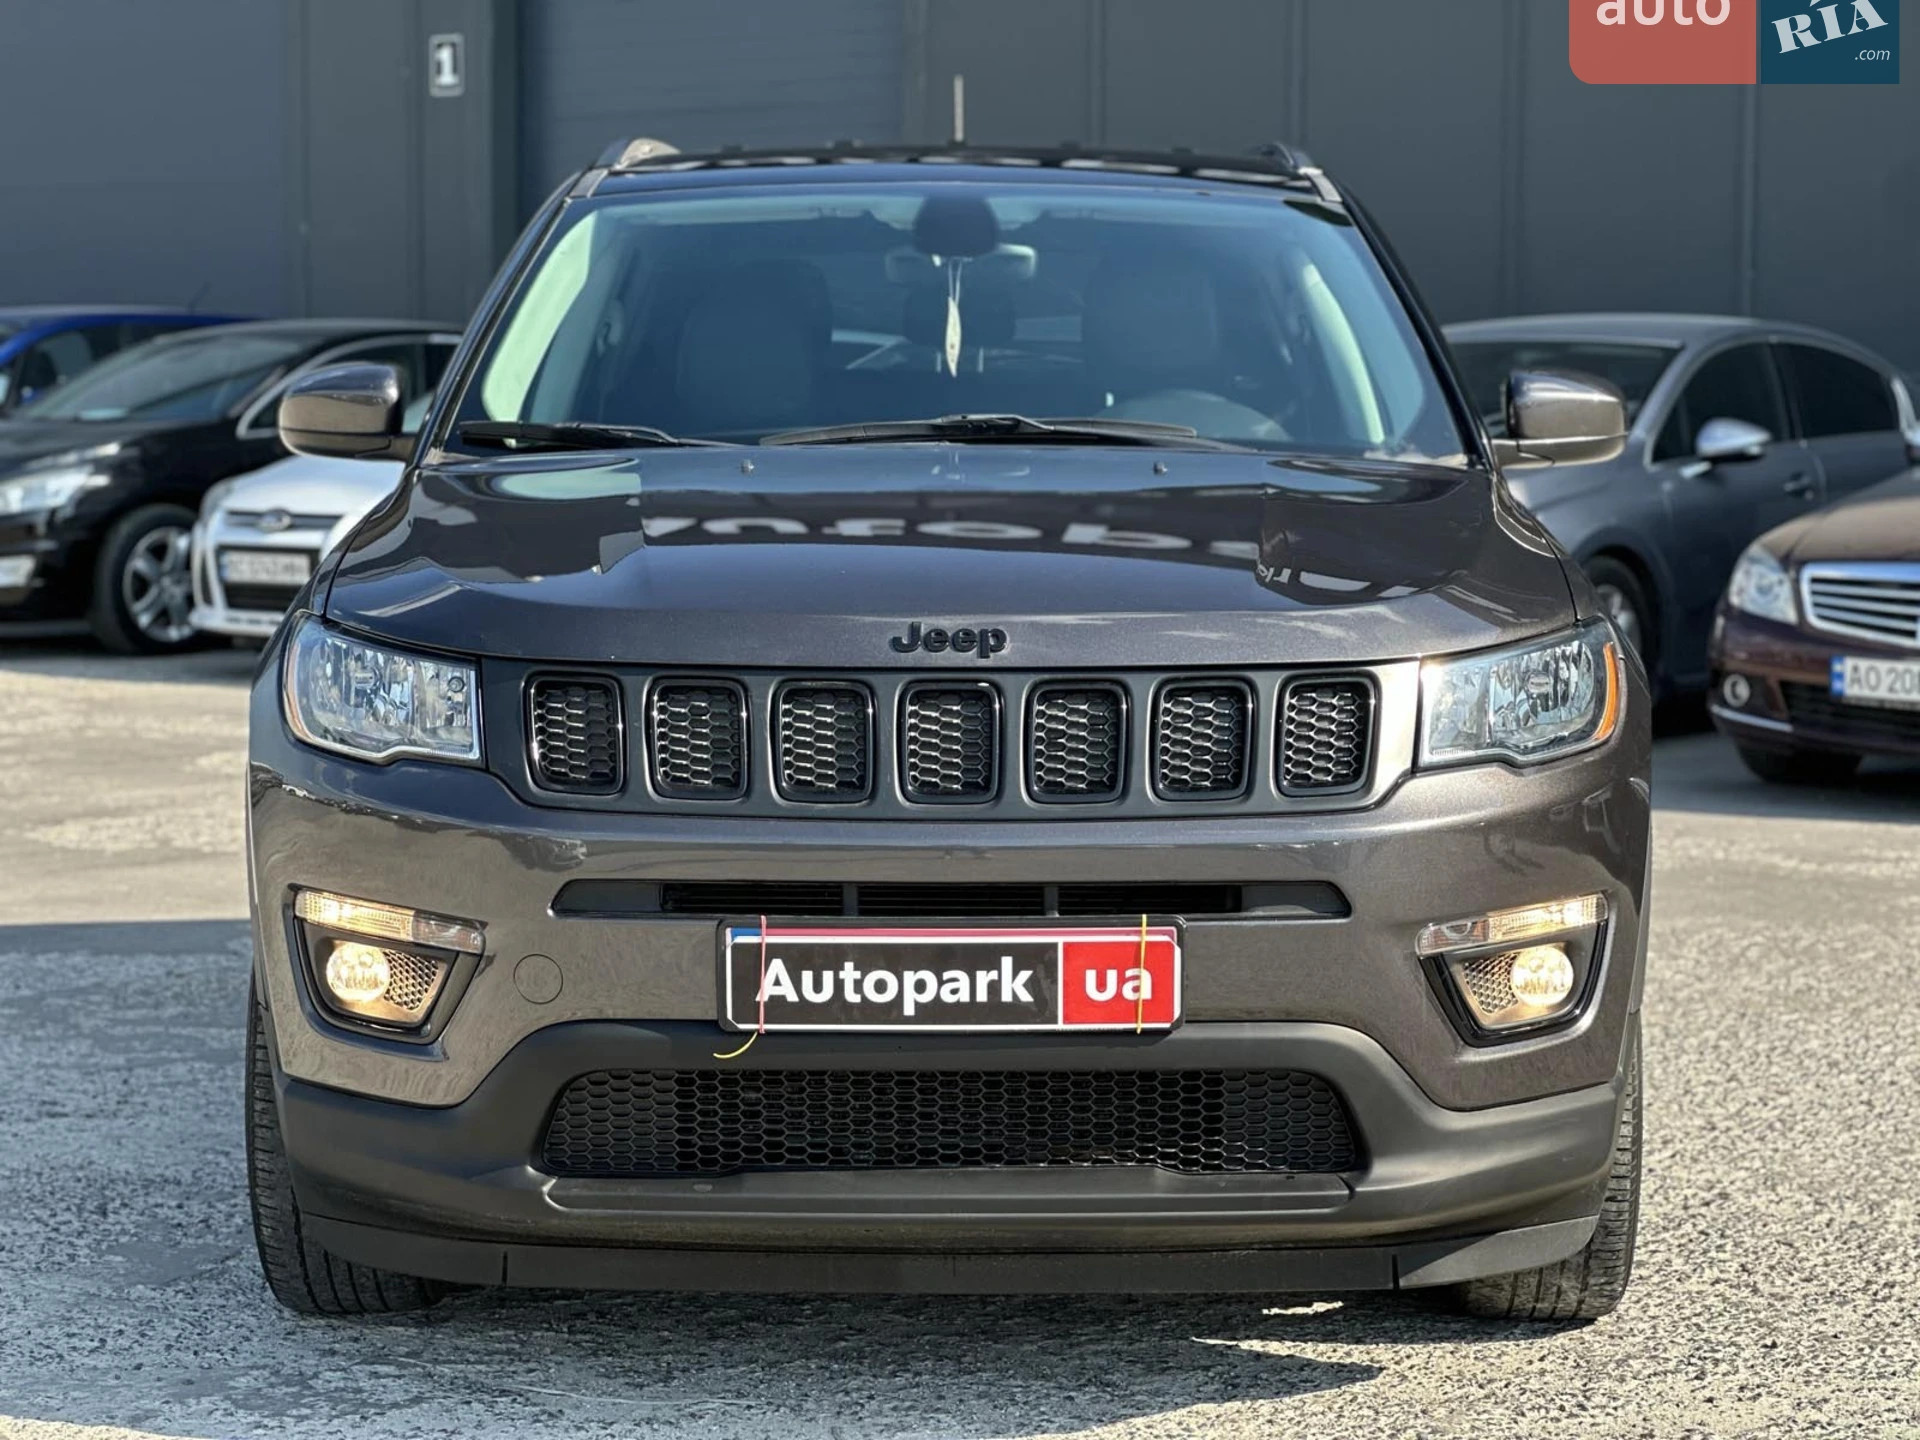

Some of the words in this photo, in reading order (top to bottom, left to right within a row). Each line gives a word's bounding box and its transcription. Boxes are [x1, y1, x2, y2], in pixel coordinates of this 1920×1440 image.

[434, 44, 461, 86] 1
[889, 621, 1008, 659] Jeep
[1885, 666, 1920, 694] 20
[755, 956, 1034, 1016] Autopark
[1085, 967, 1153, 1001] ua
